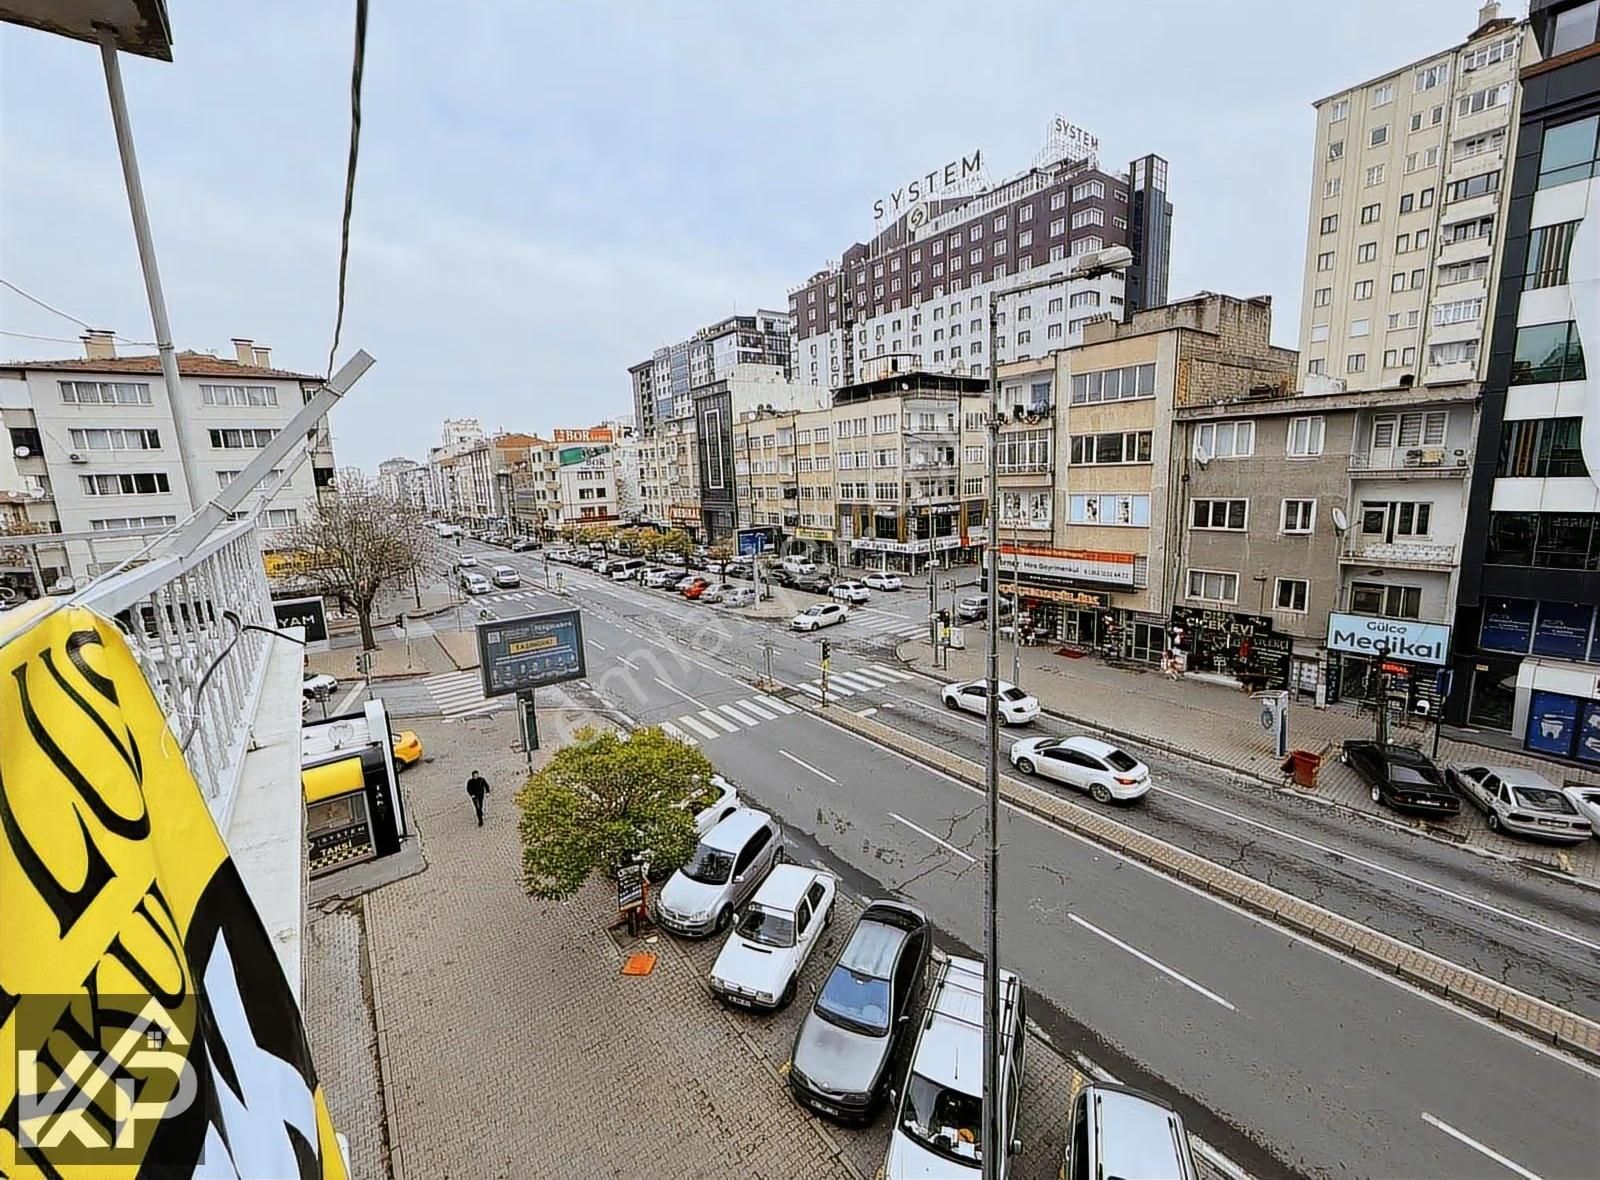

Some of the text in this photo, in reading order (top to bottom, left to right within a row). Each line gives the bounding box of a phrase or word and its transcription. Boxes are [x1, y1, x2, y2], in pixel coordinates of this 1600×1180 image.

[1055, 117, 1098, 151] SYSTEM
[873, 149, 981, 219] SYSTEM
[278, 614, 315, 627] YAM
[1334, 629, 1442, 659] Medikal
